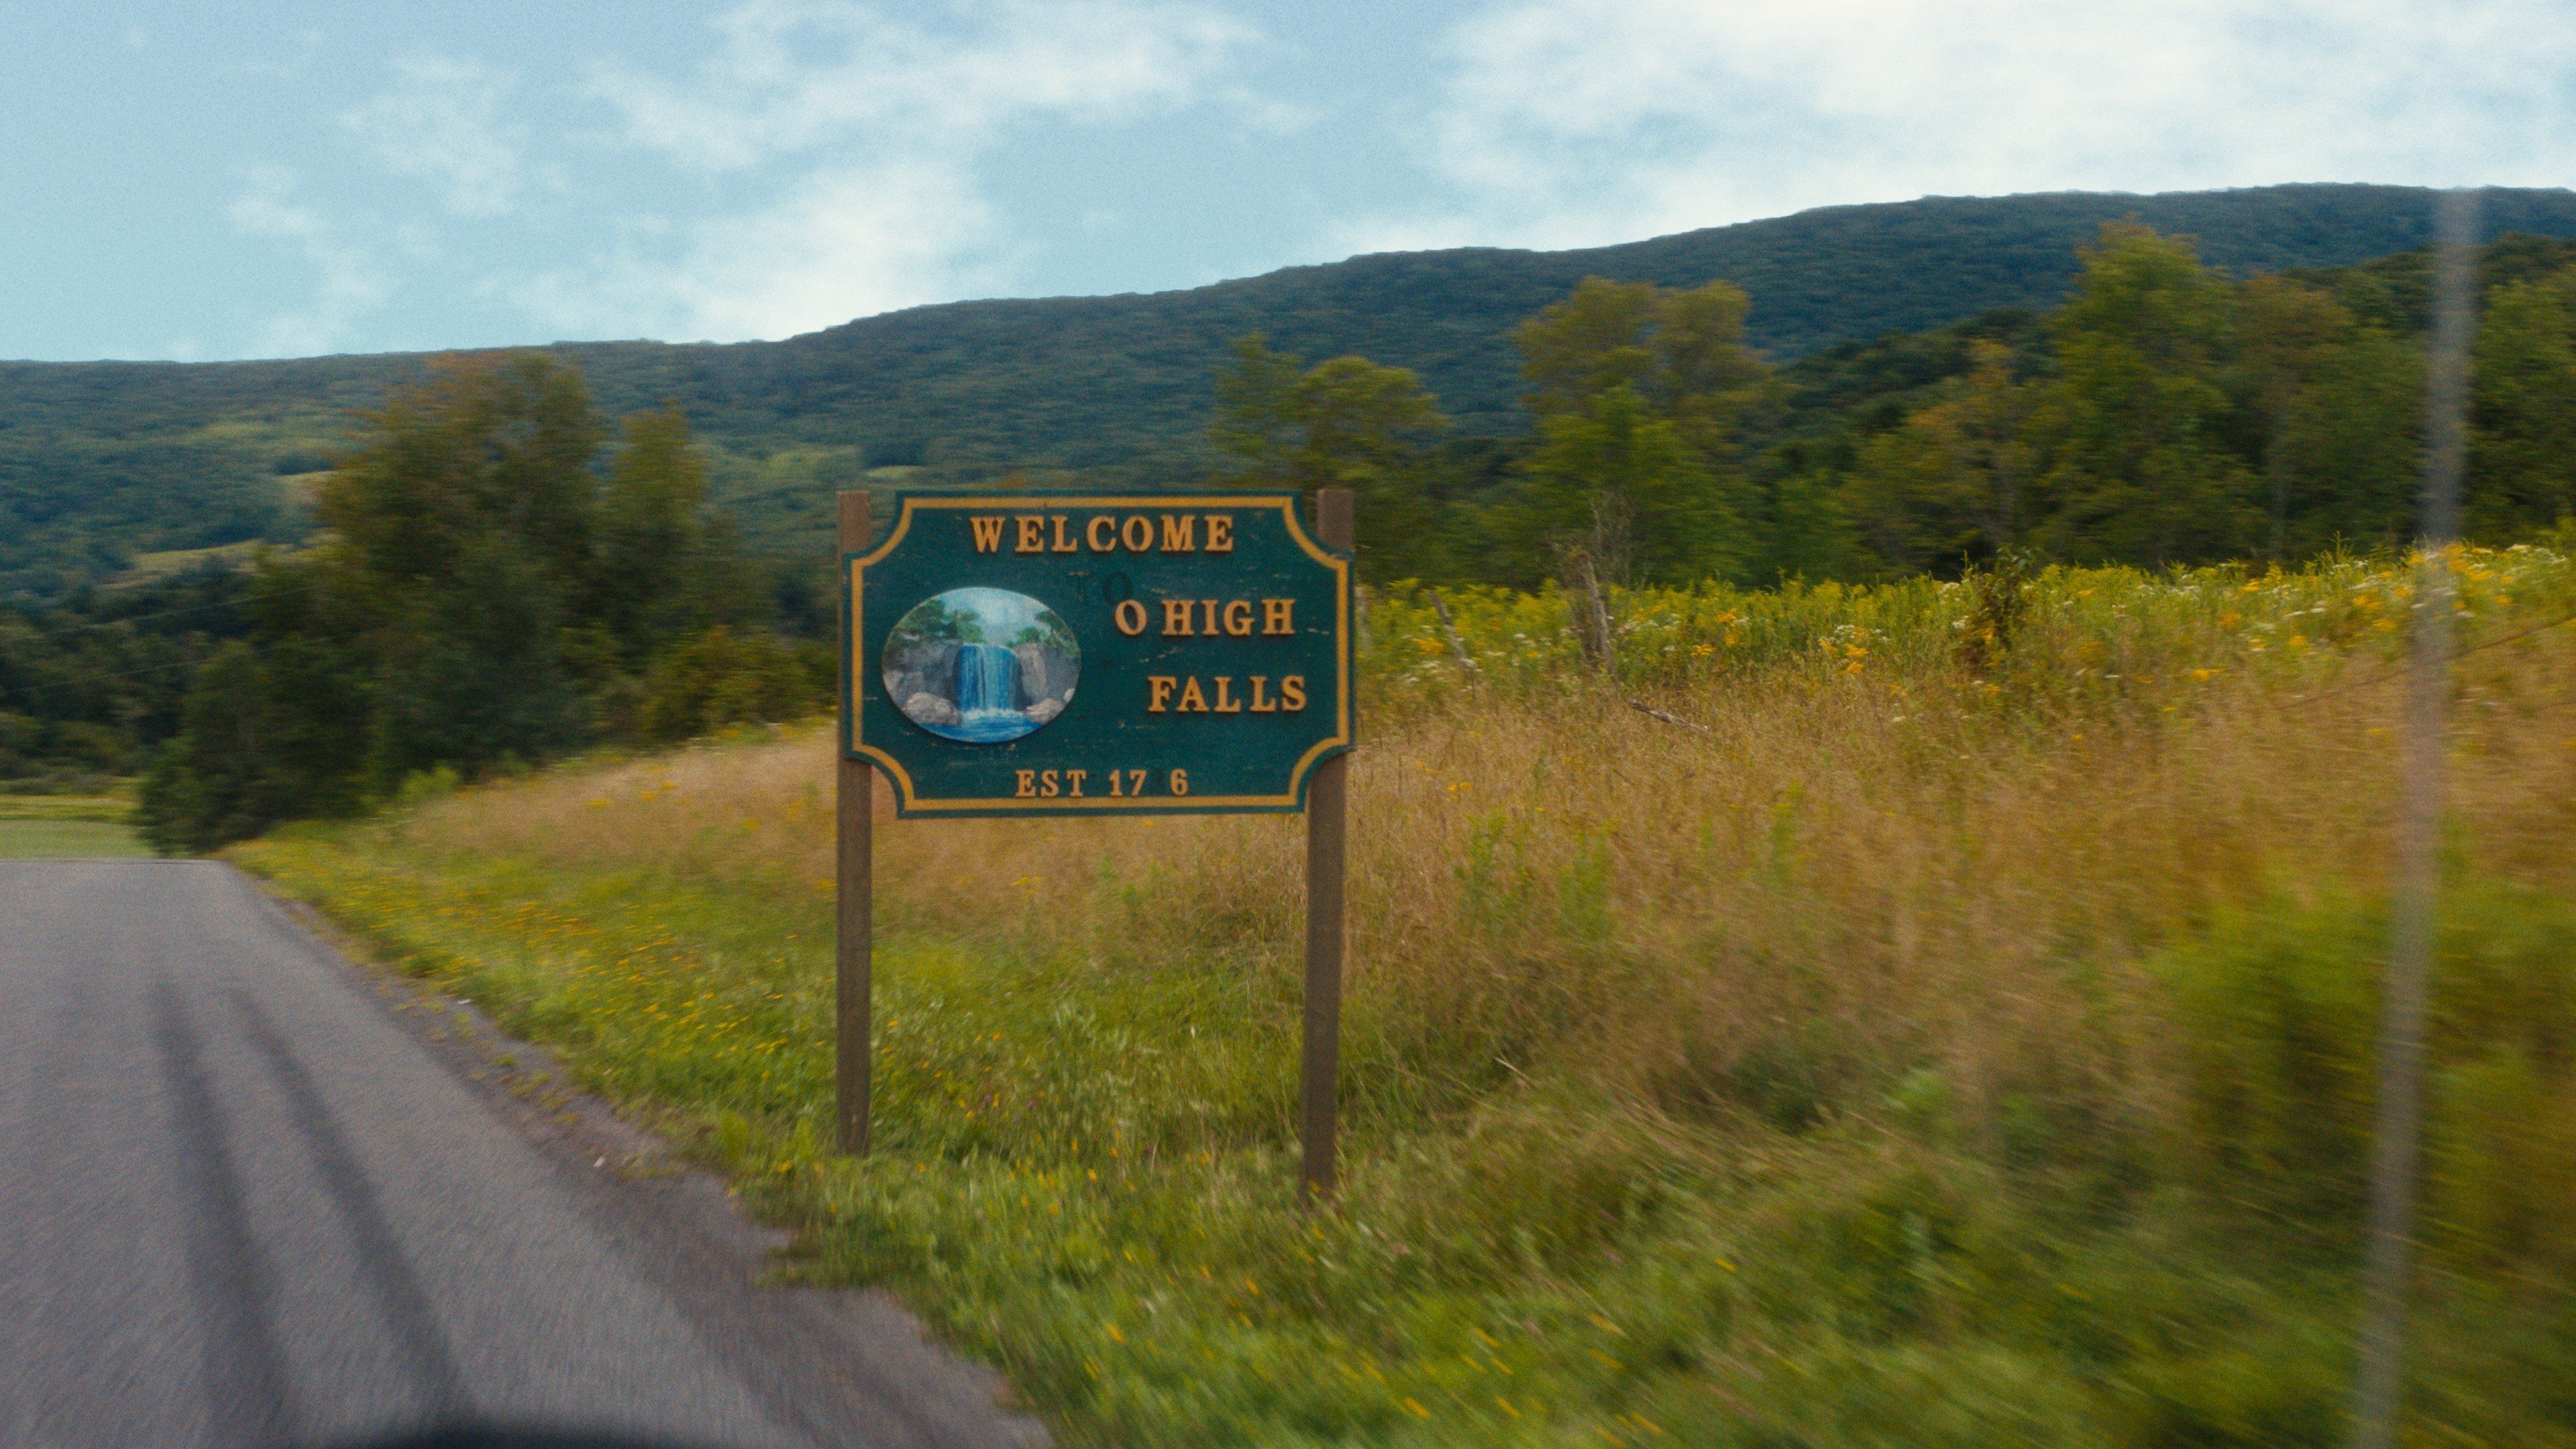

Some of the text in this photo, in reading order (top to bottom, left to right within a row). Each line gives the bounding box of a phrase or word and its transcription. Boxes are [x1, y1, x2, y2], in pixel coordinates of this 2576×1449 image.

[969, 515, 1234, 553] WELCOME
[1161, 598, 1296, 636] HIGH
[1147, 675, 1307, 712] FALLS
[1015, 768, 1189, 797] EST 176
